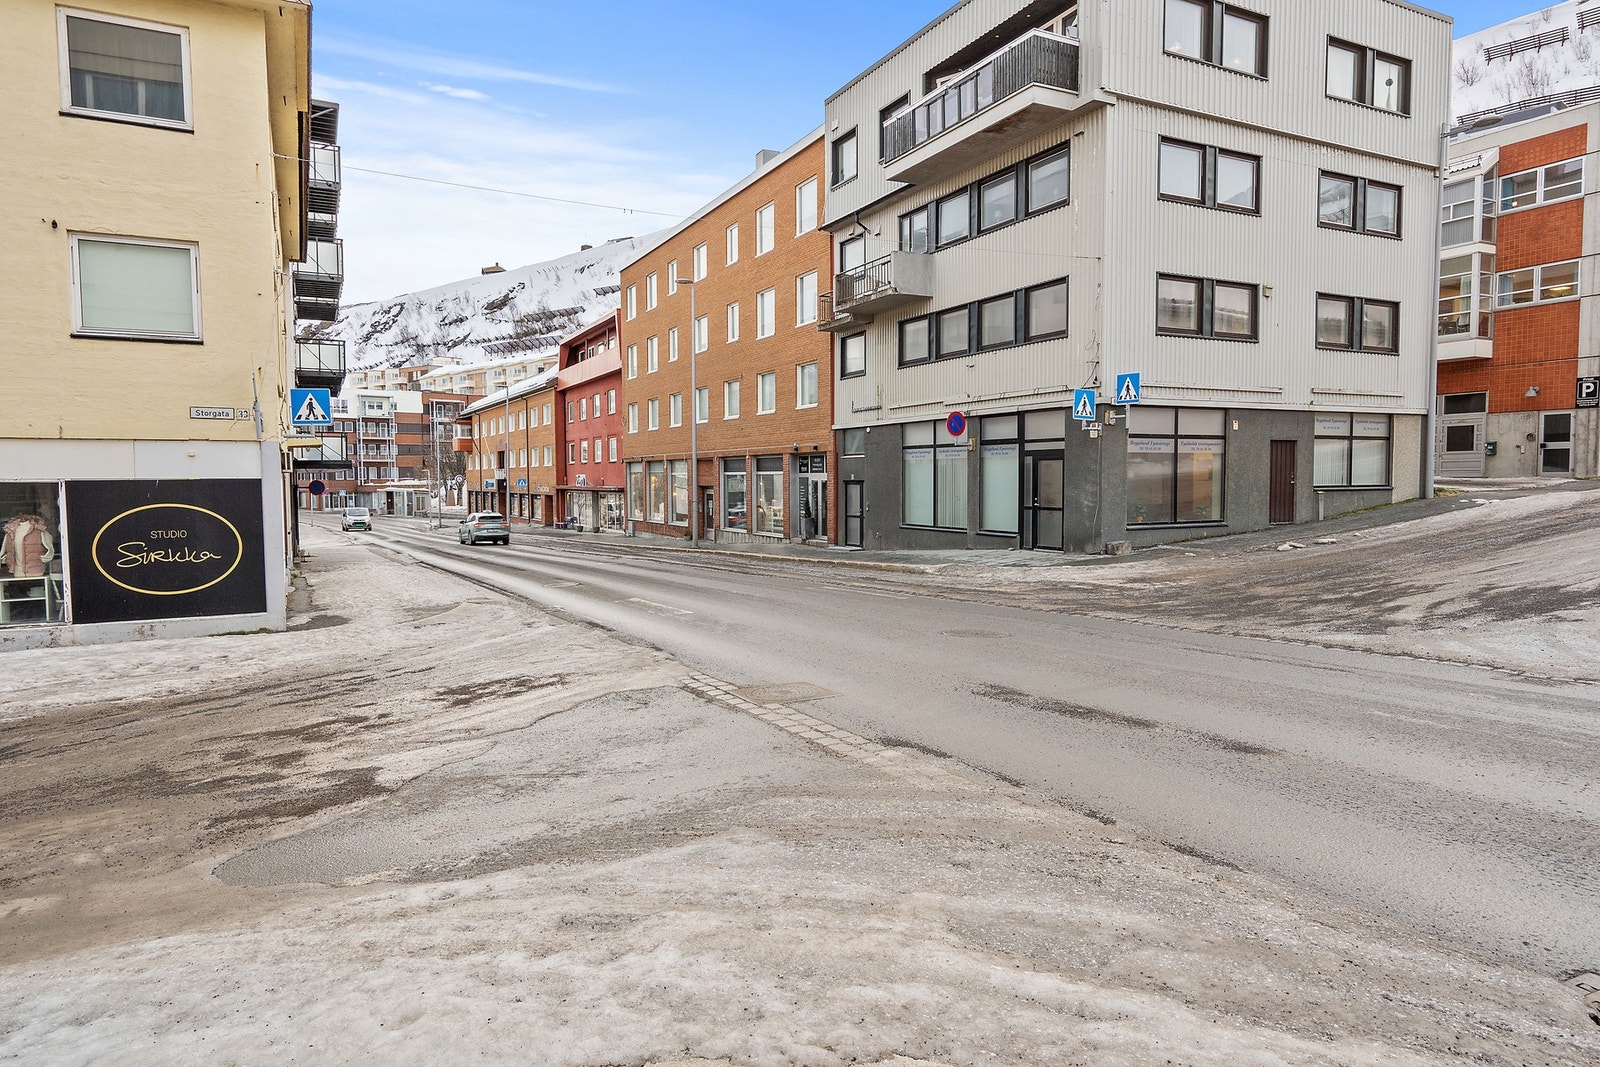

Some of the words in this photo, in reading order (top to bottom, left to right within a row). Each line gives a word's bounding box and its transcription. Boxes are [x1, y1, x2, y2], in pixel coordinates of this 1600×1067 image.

[1582, 382, 1595, 398] P
[195, 409, 229, 418] Storgata
[150, 529, 188, 539] STUDIO
